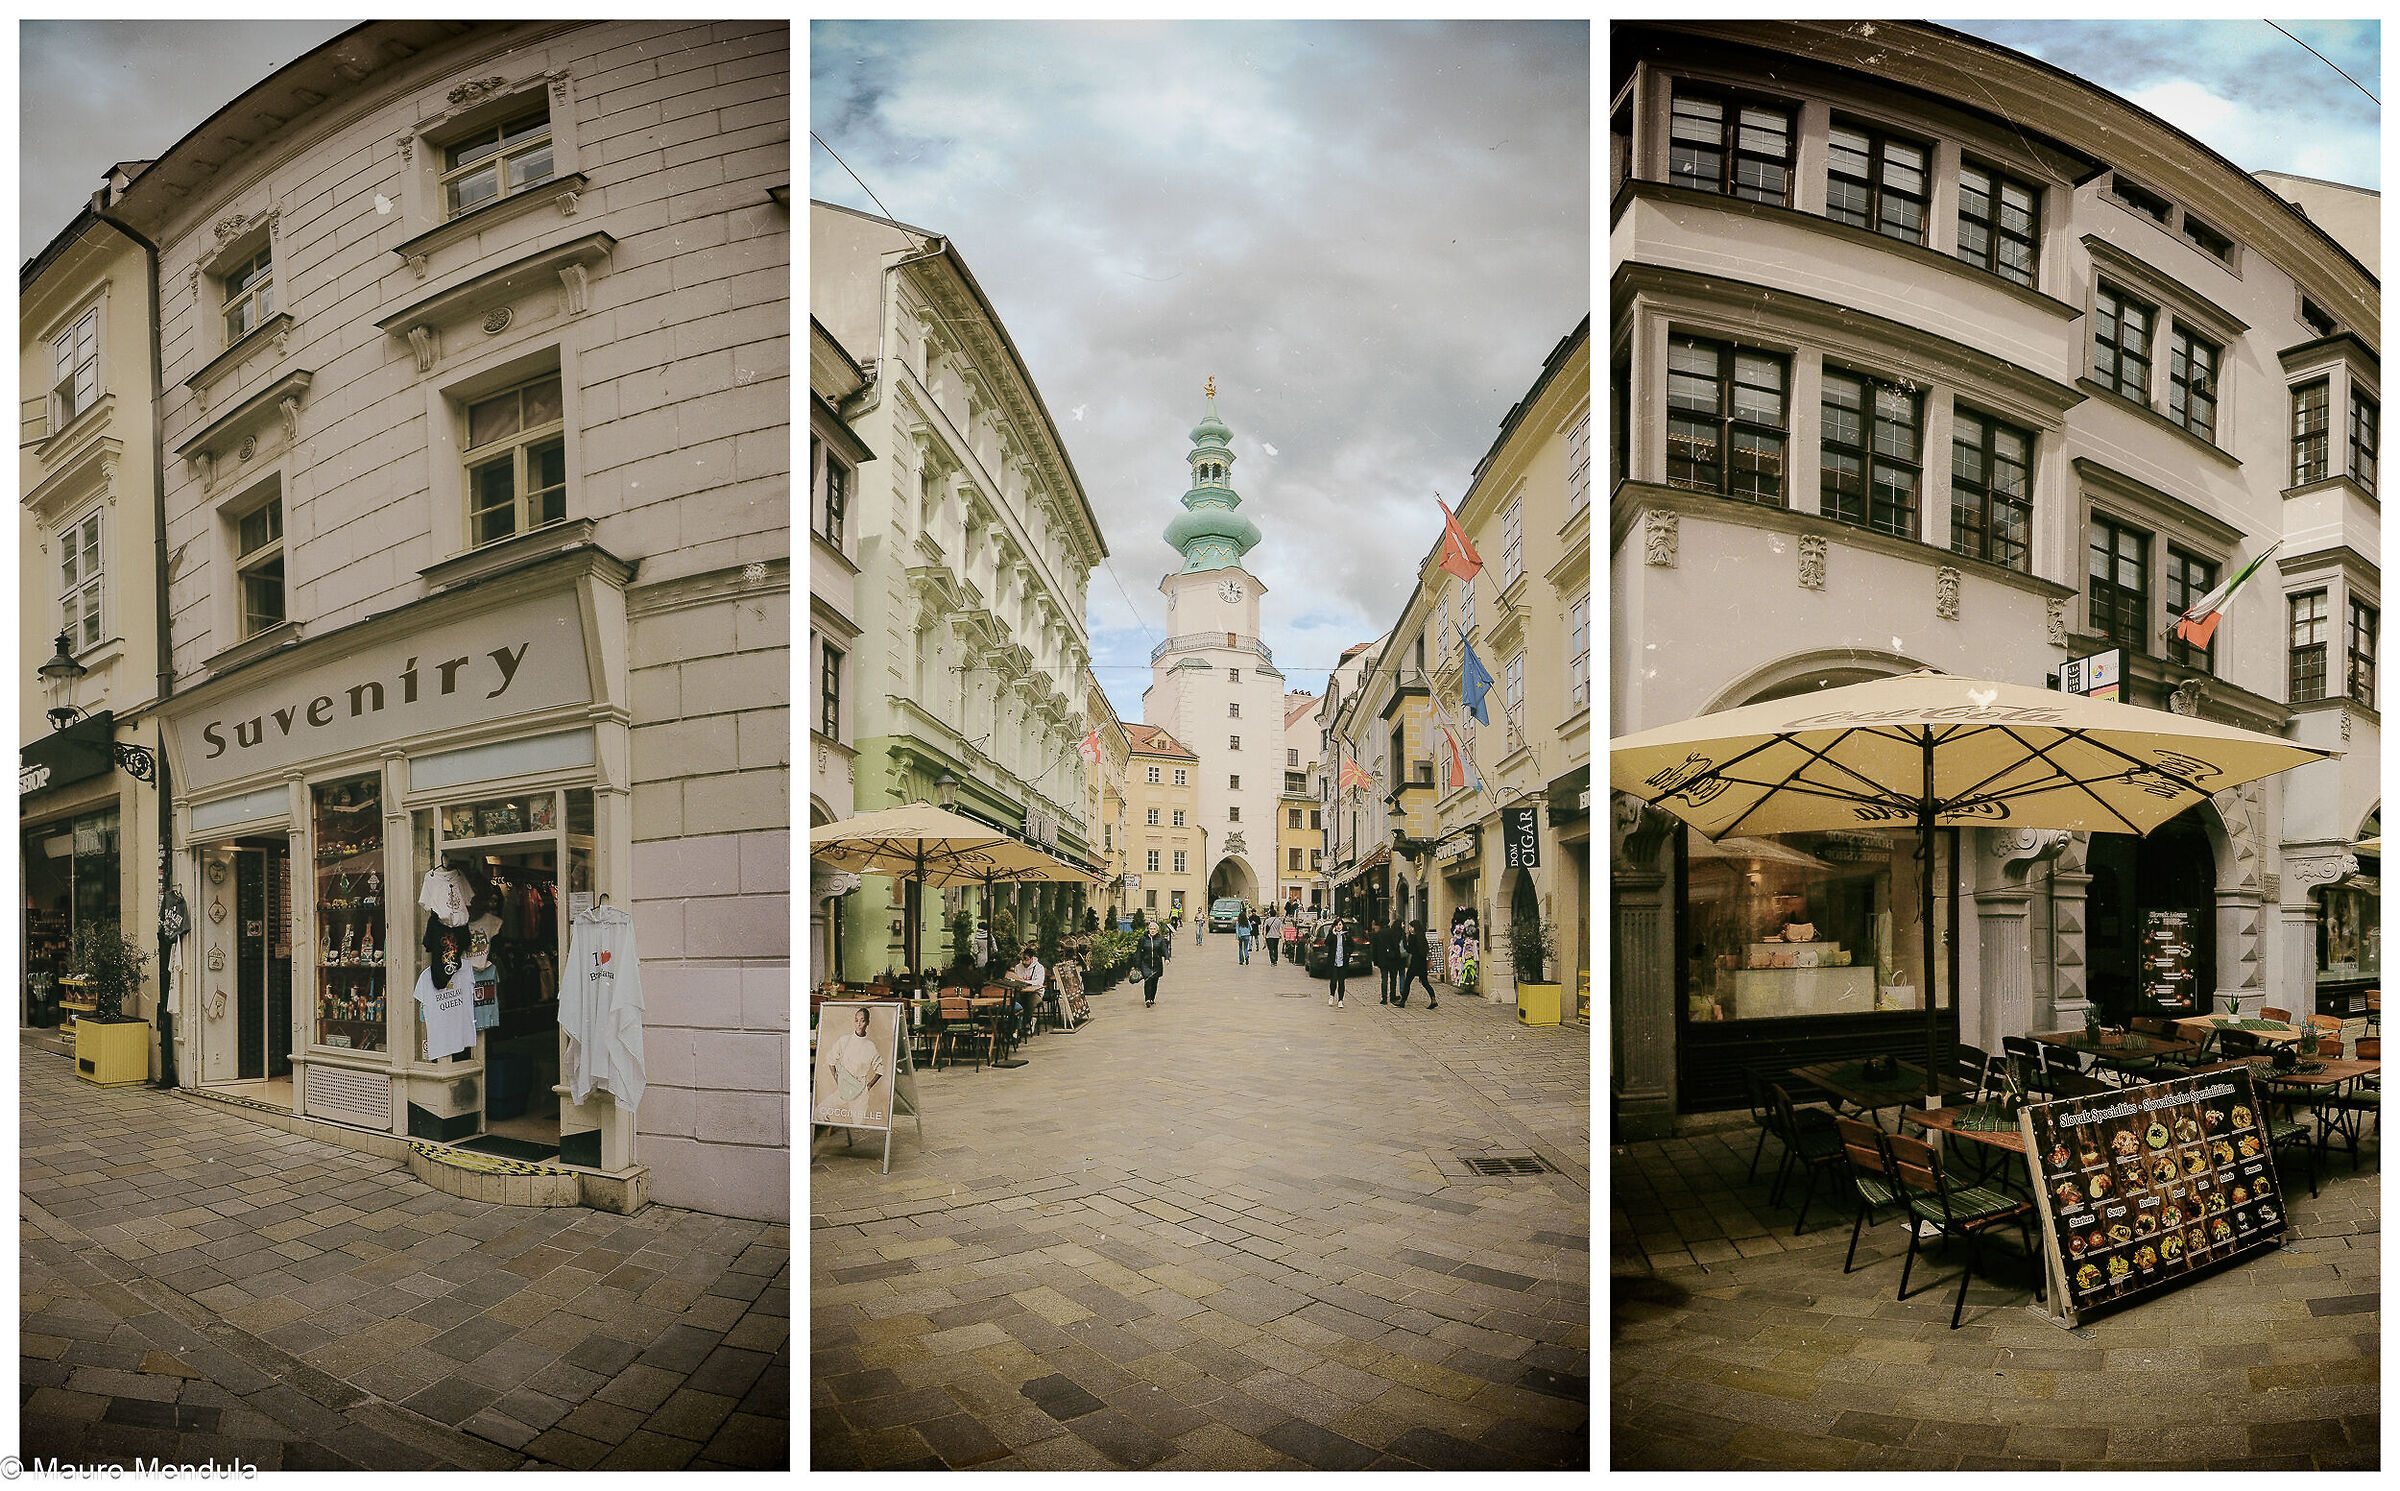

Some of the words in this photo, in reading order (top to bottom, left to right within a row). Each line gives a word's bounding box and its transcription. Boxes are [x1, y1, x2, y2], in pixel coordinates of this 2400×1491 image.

[202, 641, 530, 759] Suveníry
[1510, 843, 1519, 867] DOM
[1517, 809, 1536, 867] CIGÁR
[439, 998, 463, 1011] QUEEN
[2060, 1110, 2092, 1127] Slovak
